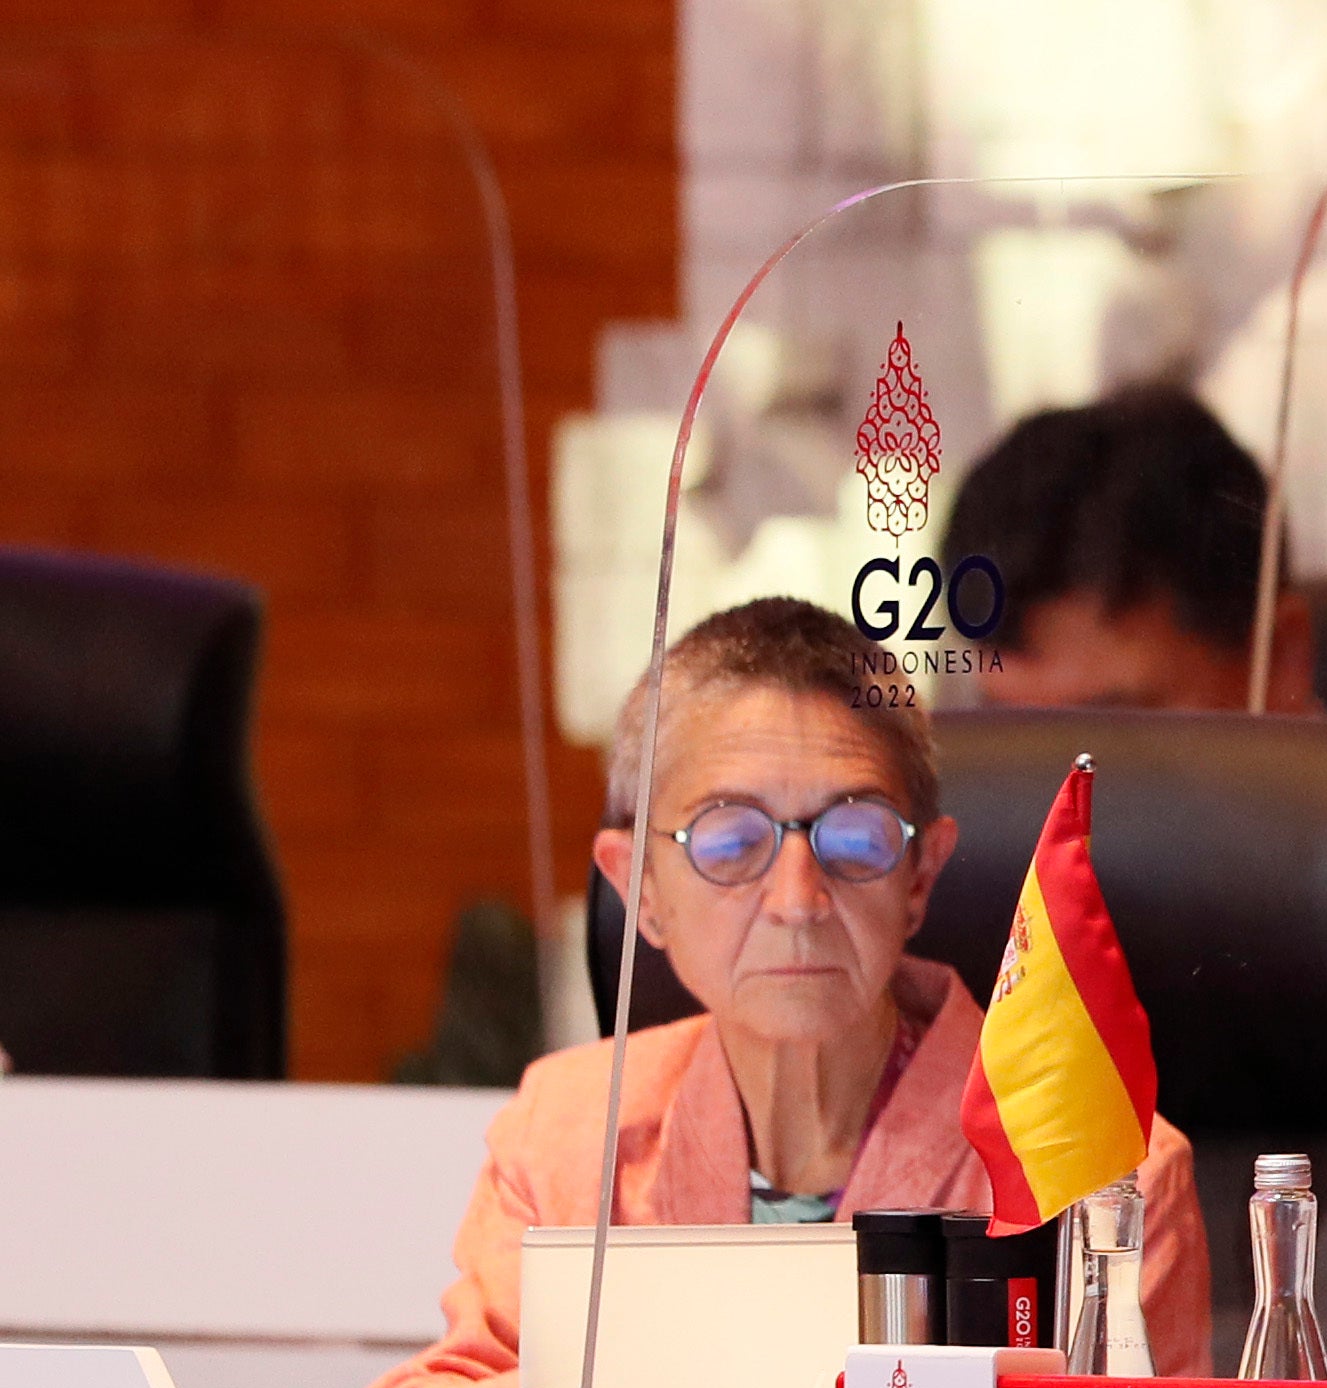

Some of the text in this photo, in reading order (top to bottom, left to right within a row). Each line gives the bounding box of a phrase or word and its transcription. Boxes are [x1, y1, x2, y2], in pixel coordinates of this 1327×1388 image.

[851, 555, 1005, 642] G20
[851, 650, 1004, 675] INDONESIA
[850, 684, 917, 709] 2022
[1015, 1296, 1032, 1336] G20
